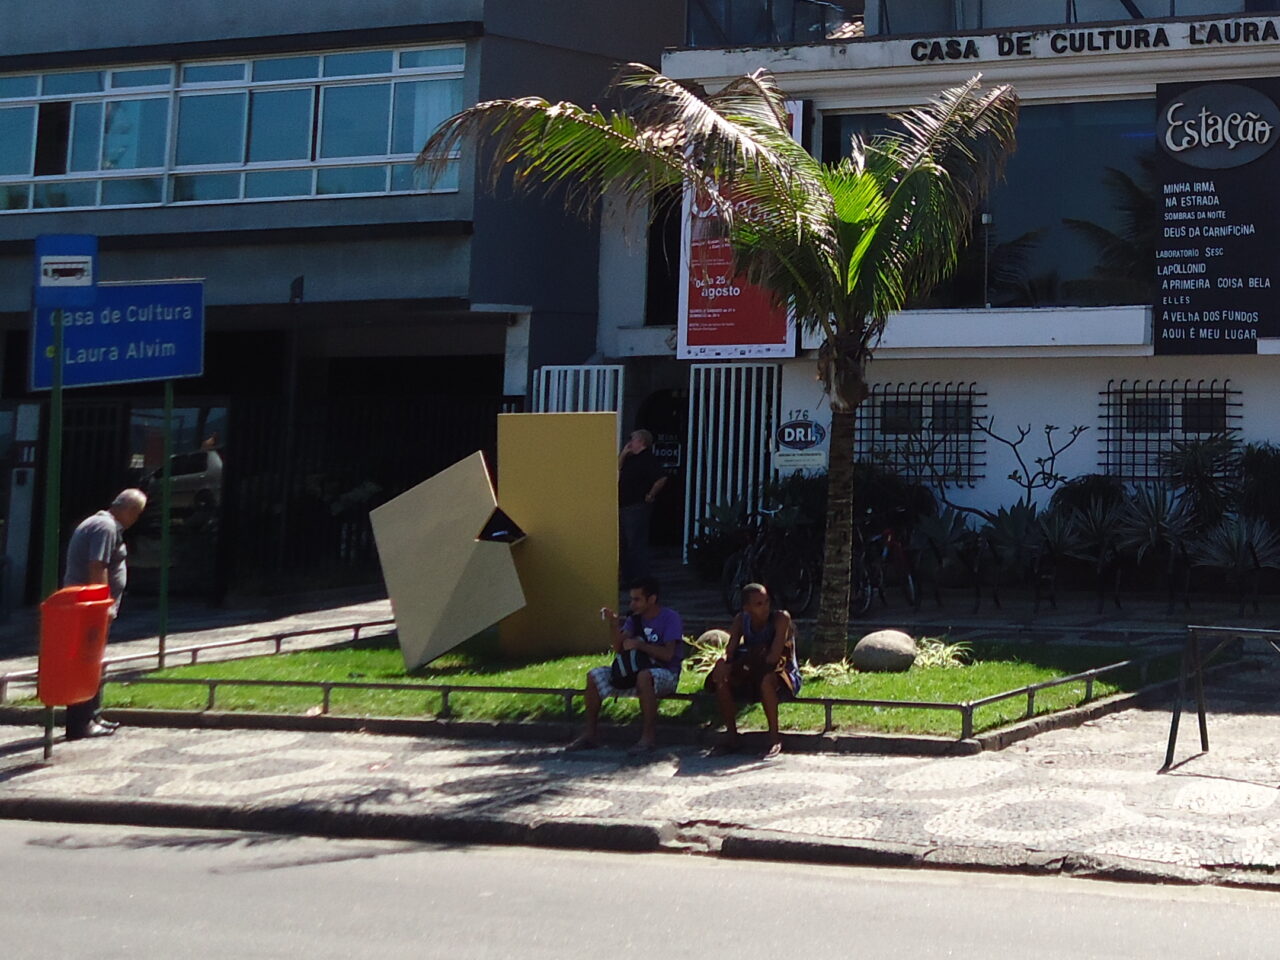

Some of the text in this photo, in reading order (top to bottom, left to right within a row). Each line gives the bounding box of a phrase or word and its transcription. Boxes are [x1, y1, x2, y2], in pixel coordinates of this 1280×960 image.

[910, 40, 980, 62] CASA
[997, 34, 1032, 57] DE
[1050, 27, 1170, 54] CULTURA
[1189, 20, 1279, 45] LAURA
[1165, 102, 1275, 152] Estação
[1163, 182, 1191, 194] MINHA
[1165, 195, 1220, 208] NA ESTRADA
[1164, 210, 1226, 221] SOMBRAS DA NOITE
[1164, 226, 1187, 238] DEUS
[1188, 226, 1200, 238] DA
[1162, 277, 1271, 290] A PRIMEIRA COISA BELA
[701, 286, 741, 300] agosto
[1162, 296, 1190, 305] ELLES
[100, 306, 122, 325] de
[126, 303, 193, 323] Cultura
[1162, 311, 1169, 322] A
[1203, 311, 1220, 322] DOS
[1162, 328, 1185, 339] AQUI
[1199, 328, 1220, 339] MEU
[1225, 328, 1257, 340] LUGAR
[65, 339, 177, 365] Laura Alvim
[788, 409, 809, 421] 176
